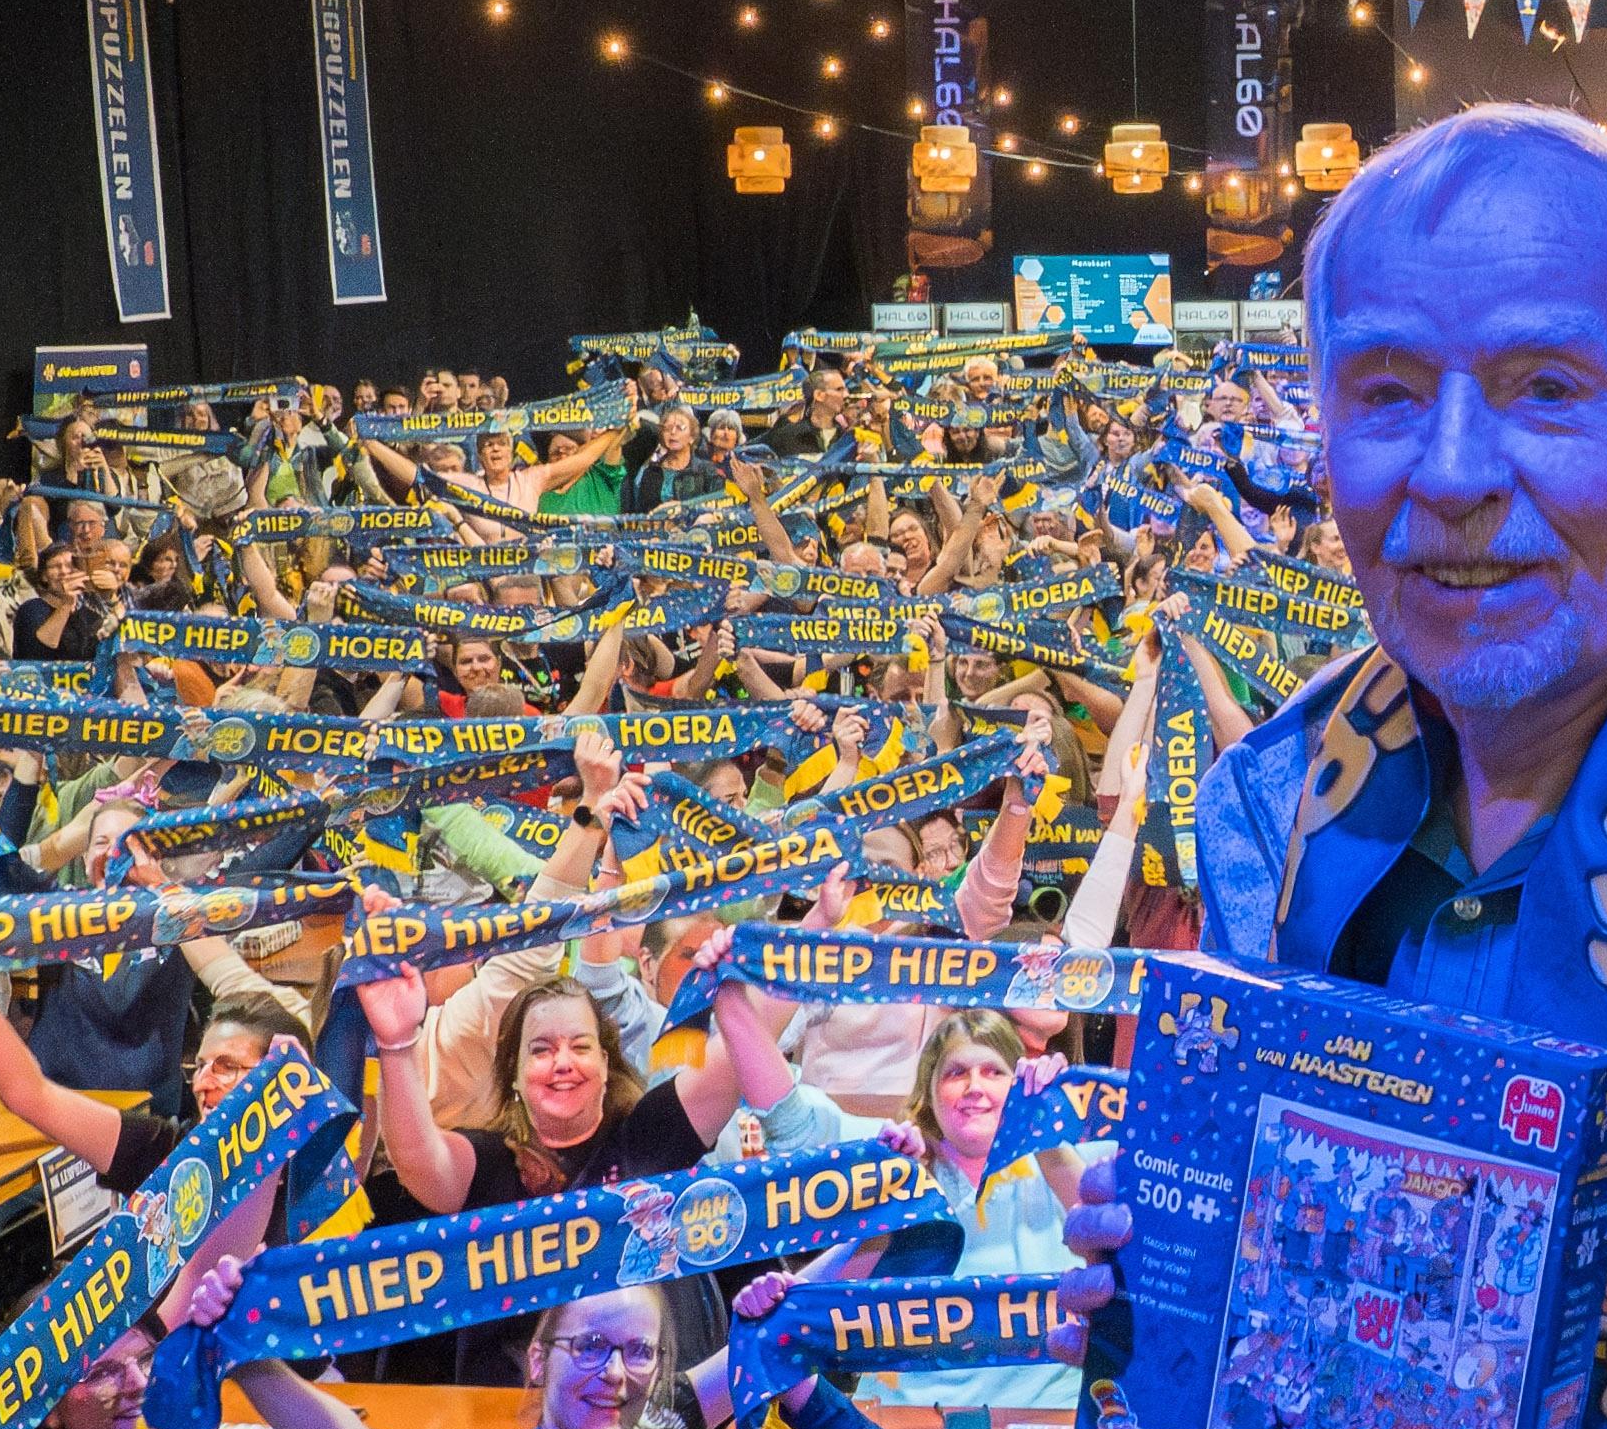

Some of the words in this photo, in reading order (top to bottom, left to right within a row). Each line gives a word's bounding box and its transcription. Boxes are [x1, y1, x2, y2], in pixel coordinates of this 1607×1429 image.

[446, 411, 485, 428] HIEP
[534, 407, 593, 422] HOERA
[916, 402, 949, 418] HIEP
[361, 510, 432, 527] HOERA
[424, 549, 472, 566] HIEP
[479, 547, 528, 565] HIEP
[644, 551, 692, 571] HIEP
[698, 557, 747, 580] HIEP
[807, 574, 880, 598] HOERA
[416, 604, 464, 626] HIEP
[471, 614, 525, 632] HIEP
[1217, 584, 1277, 614] HIEP
[1286, 600, 1349, 631] HIEP
[184, 624, 249, 650] HIEP
[792, 620, 841, 640] HIEP
[849, 618, 897, 639] HIEP
[1205, 612, 1256, 660] HIEP
[81, 714, 164, 742] HIEP
[452, 723, 525, 751] HIEP
[620, 715, 736, 746] HOERA
[1171, 710, 1195, 826] HOERA
[839, 763, 964, 817] HOERA
[684, 829, 841, 891] HOERA
[32, 894, 136, 942] HIEP
[763, 944, 873, 982] HIEP
[892, 949, 996, 986] HIEP
[1324, 1035, 1373, 1061] JAN
[1256, 1047, 1286, 1067] VAN
[1290, 1051, 1434, 1105] HAASTEREN
[1510, 1095, 1555, 1121] Jumbo
[1134, 1149, 1180, 1178] Comic
[1183, 1167, 1233, 1192] puzzle
[1137, 1179, 1182, 1213] 500
[301, 1254, 444, 1326] HIEP
[468, 1217, 601, 1293] HIEP
[764, 1154, 939, 1228] HOERA
[49, 1251, 132, 1362] HIEP
[833, 1298, 974, 1350] HIEP
